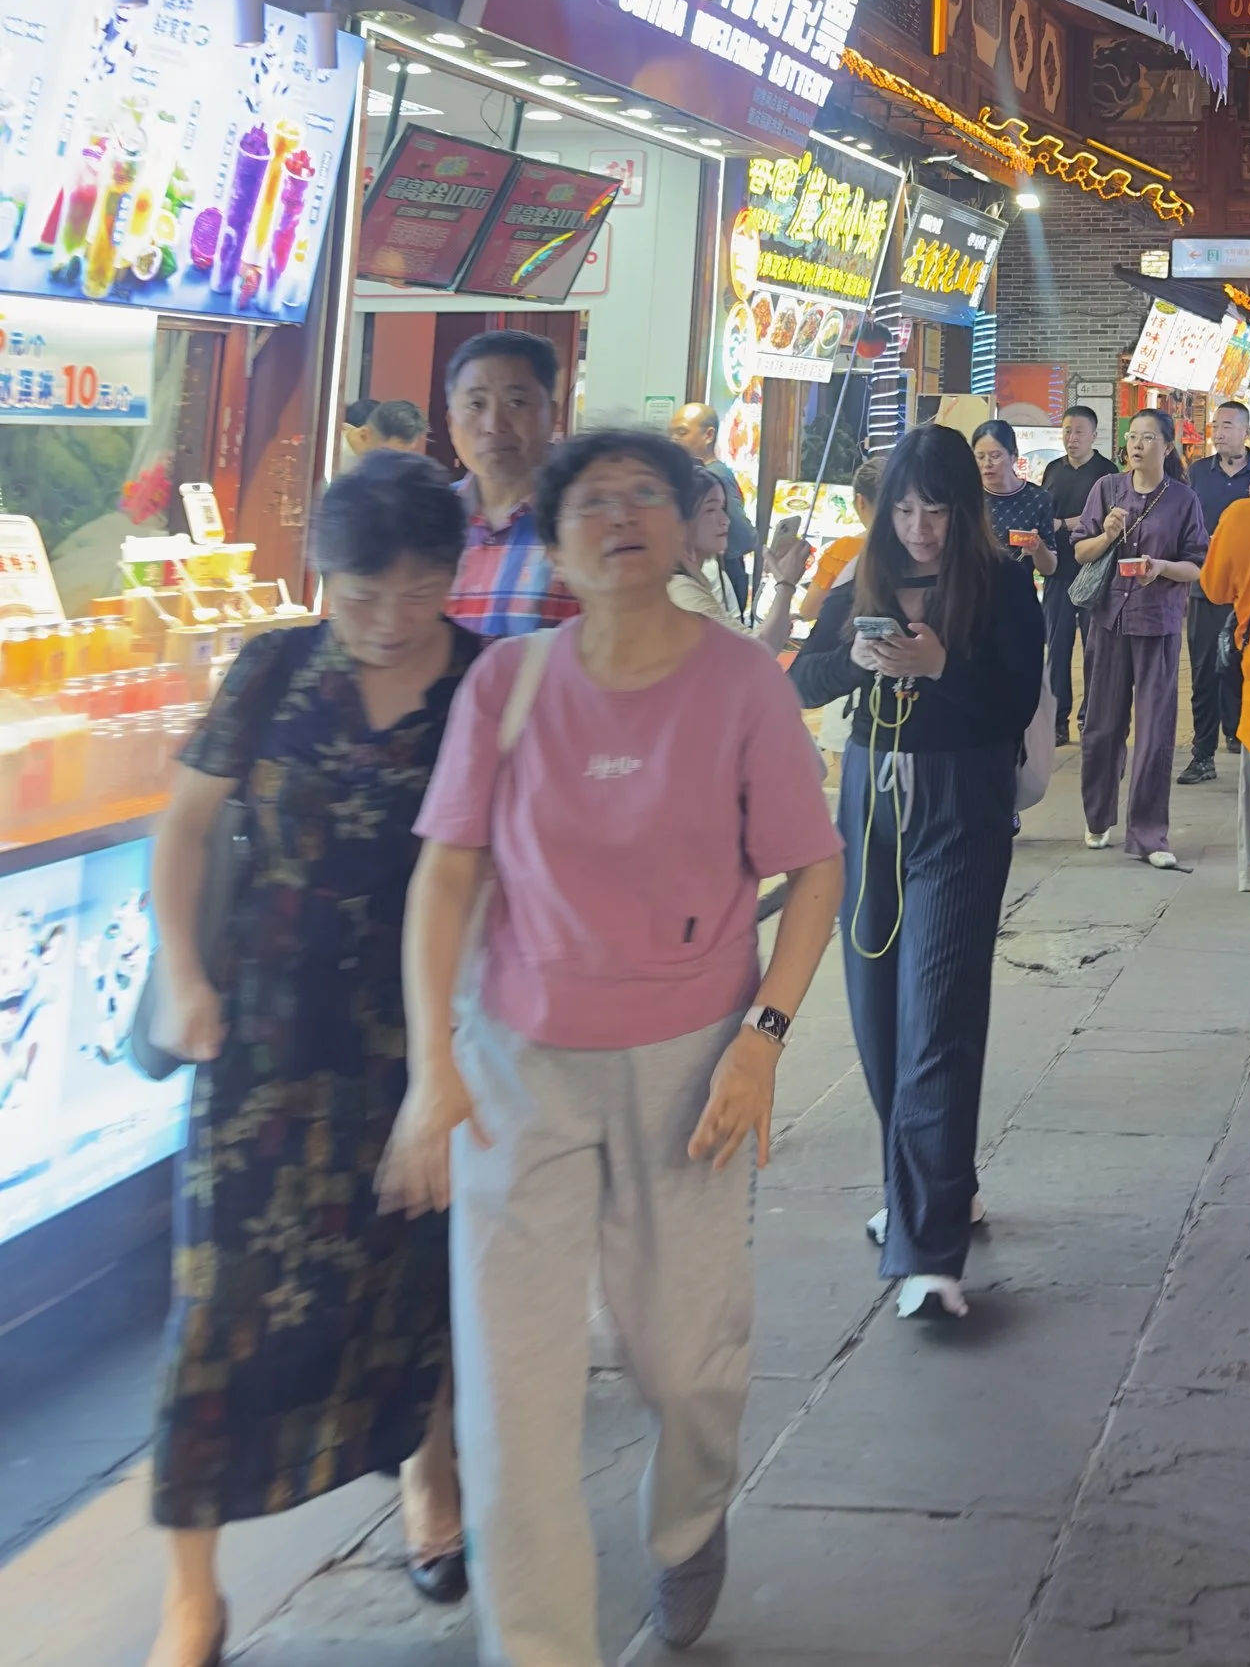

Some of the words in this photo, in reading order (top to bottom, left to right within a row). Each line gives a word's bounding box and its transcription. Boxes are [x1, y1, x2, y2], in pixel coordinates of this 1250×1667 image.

[690, 9, 769, 77] WELFARE
[768, 50, 834, 108] LOTTERY
[1132, 315, 1168, 377] 怪味胡豆
